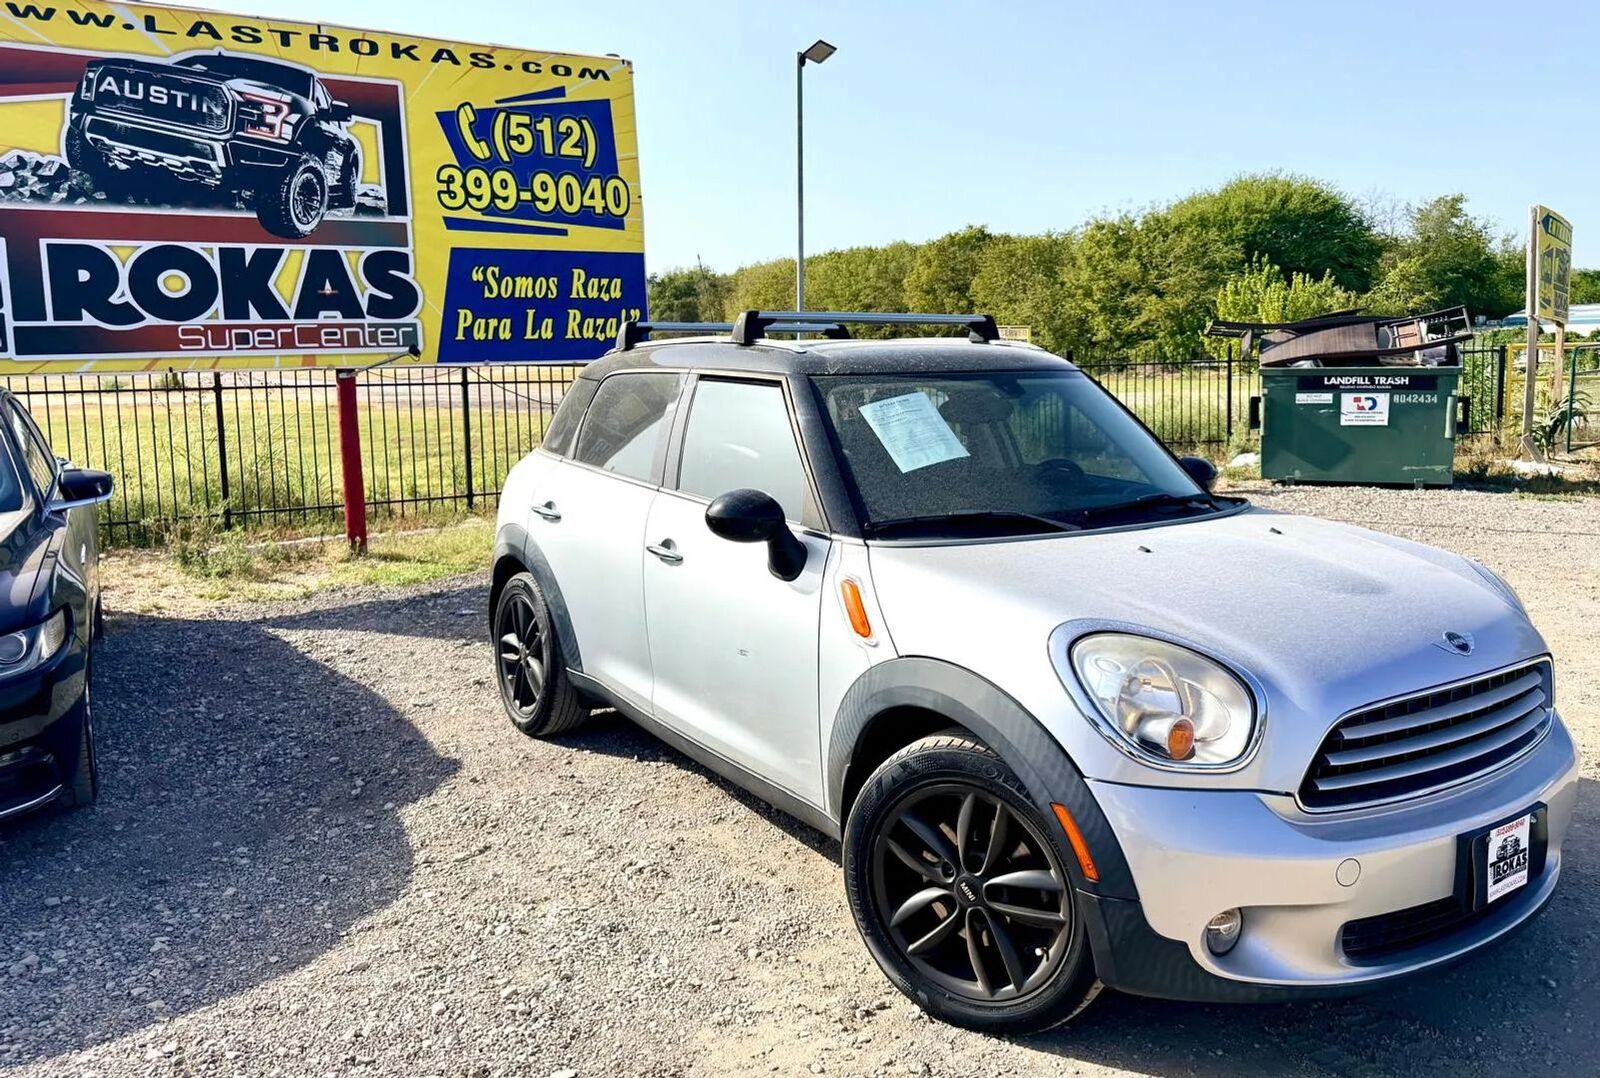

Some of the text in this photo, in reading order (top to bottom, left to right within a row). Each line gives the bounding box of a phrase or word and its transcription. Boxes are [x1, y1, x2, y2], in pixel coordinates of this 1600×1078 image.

[98, 76, 222, 115] AUSTIN
[493, 110, 597, 170] (512)
[437, 165, 629, 218] 399-9040
[569, 268, 622, 301] Raza
[178, 323, 414, 351] SuperCenter
[454, 308, 512, 341] Para
[523, 308, 554, 340] La
[1324, 376, 1409, 385] LANDFILL TRASH
[960, 881, 976, 901] MINI
